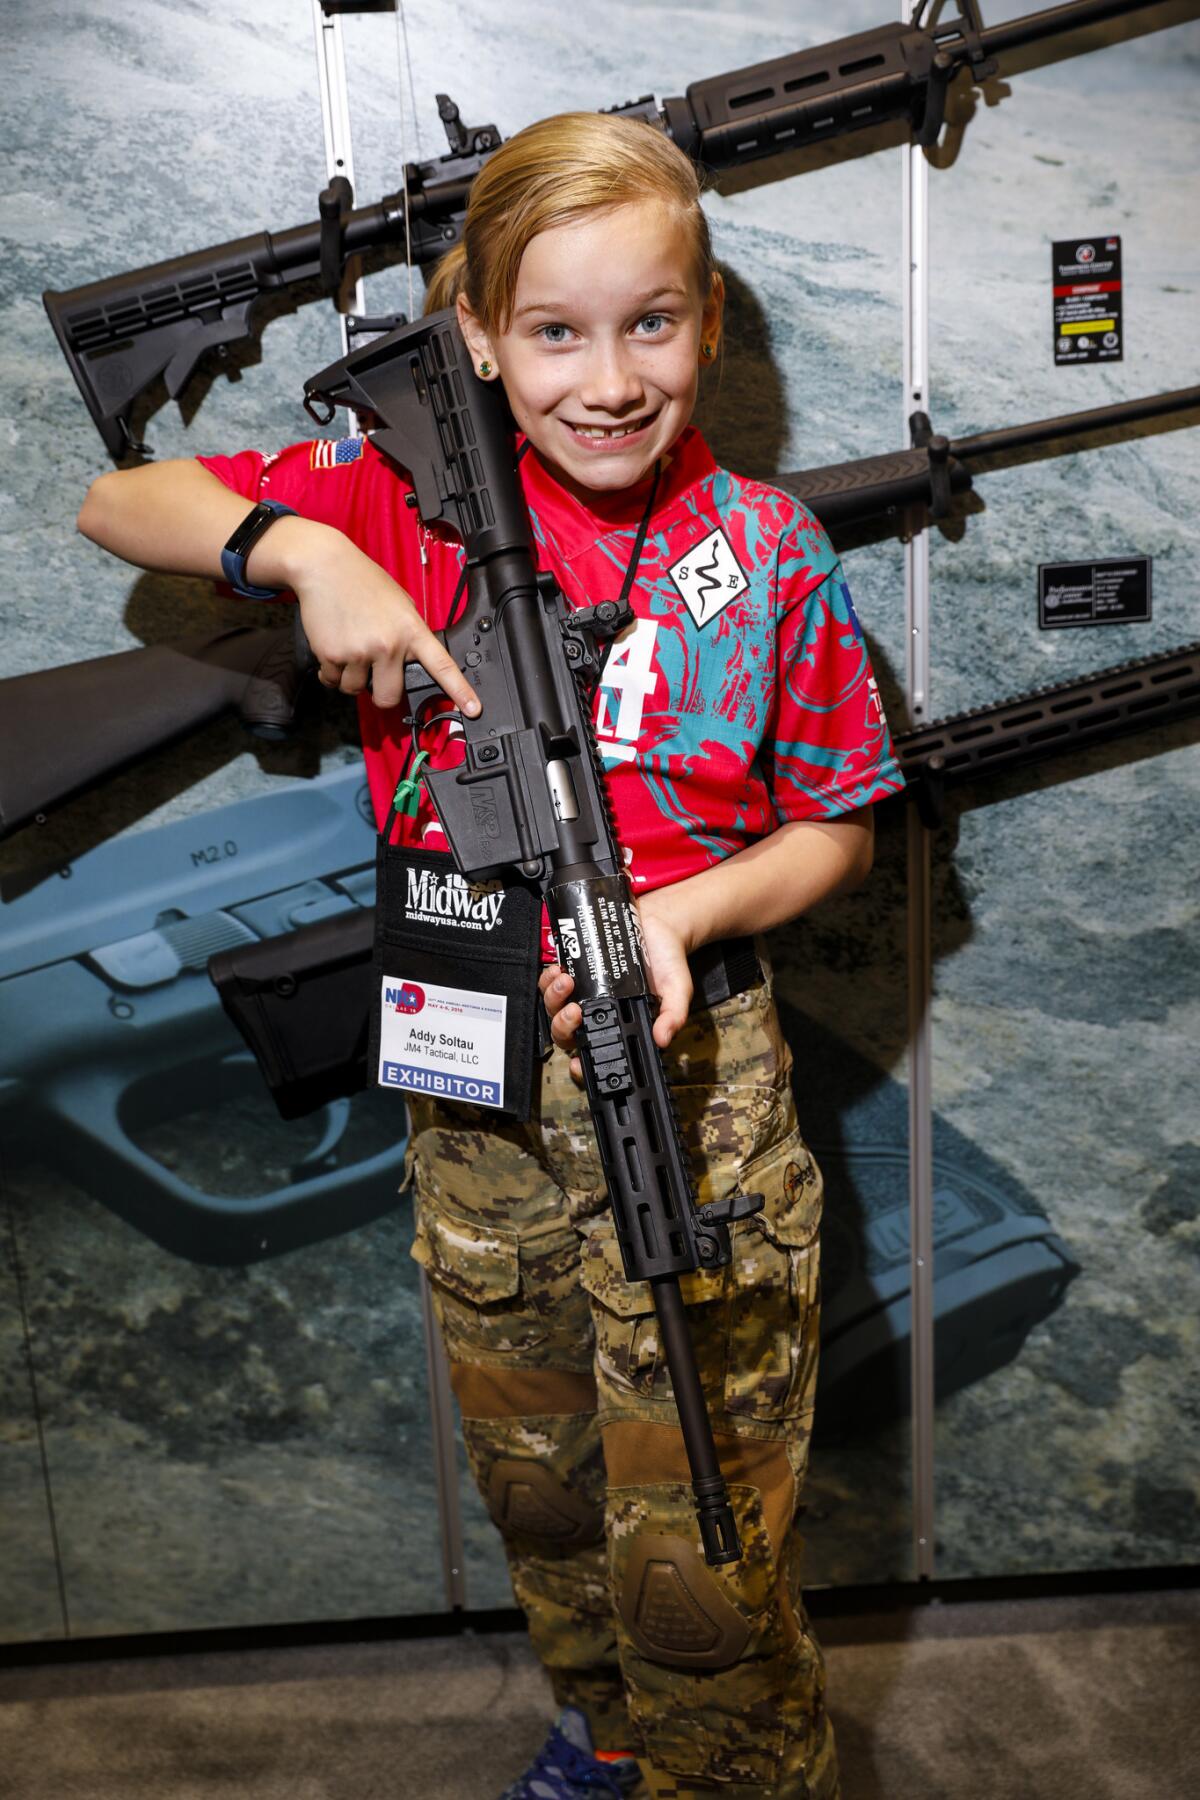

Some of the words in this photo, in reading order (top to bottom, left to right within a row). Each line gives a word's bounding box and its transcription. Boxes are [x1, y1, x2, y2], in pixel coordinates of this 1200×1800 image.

[679, 566, 688, 580] S
[727, 574, 739, 589] E
[189, 840, 239, 868] M2.0
[597, 897, 608, 920] SLIM
[607, 901, 618, 923] NEW
[405, 910, 483, 931] midwayusa.com
[557, 917, 581, 959] M&P
[576, 905, 590, 945] FOLDING
[585, 947, 598, 980] SIGHTS
[602, 922, 621, 979] HANDGUARD
[409, 1028, 436, 1045] Addy
[440, 1033, 474, 1050] Soltau
[404, 1042, 422, 1054] JM4
[424, 1045, 458, 1062] Tactical,
[461, 1053, 479, 1065] LLC
[387, 1066, 494, 1101] EXHIBITOR
